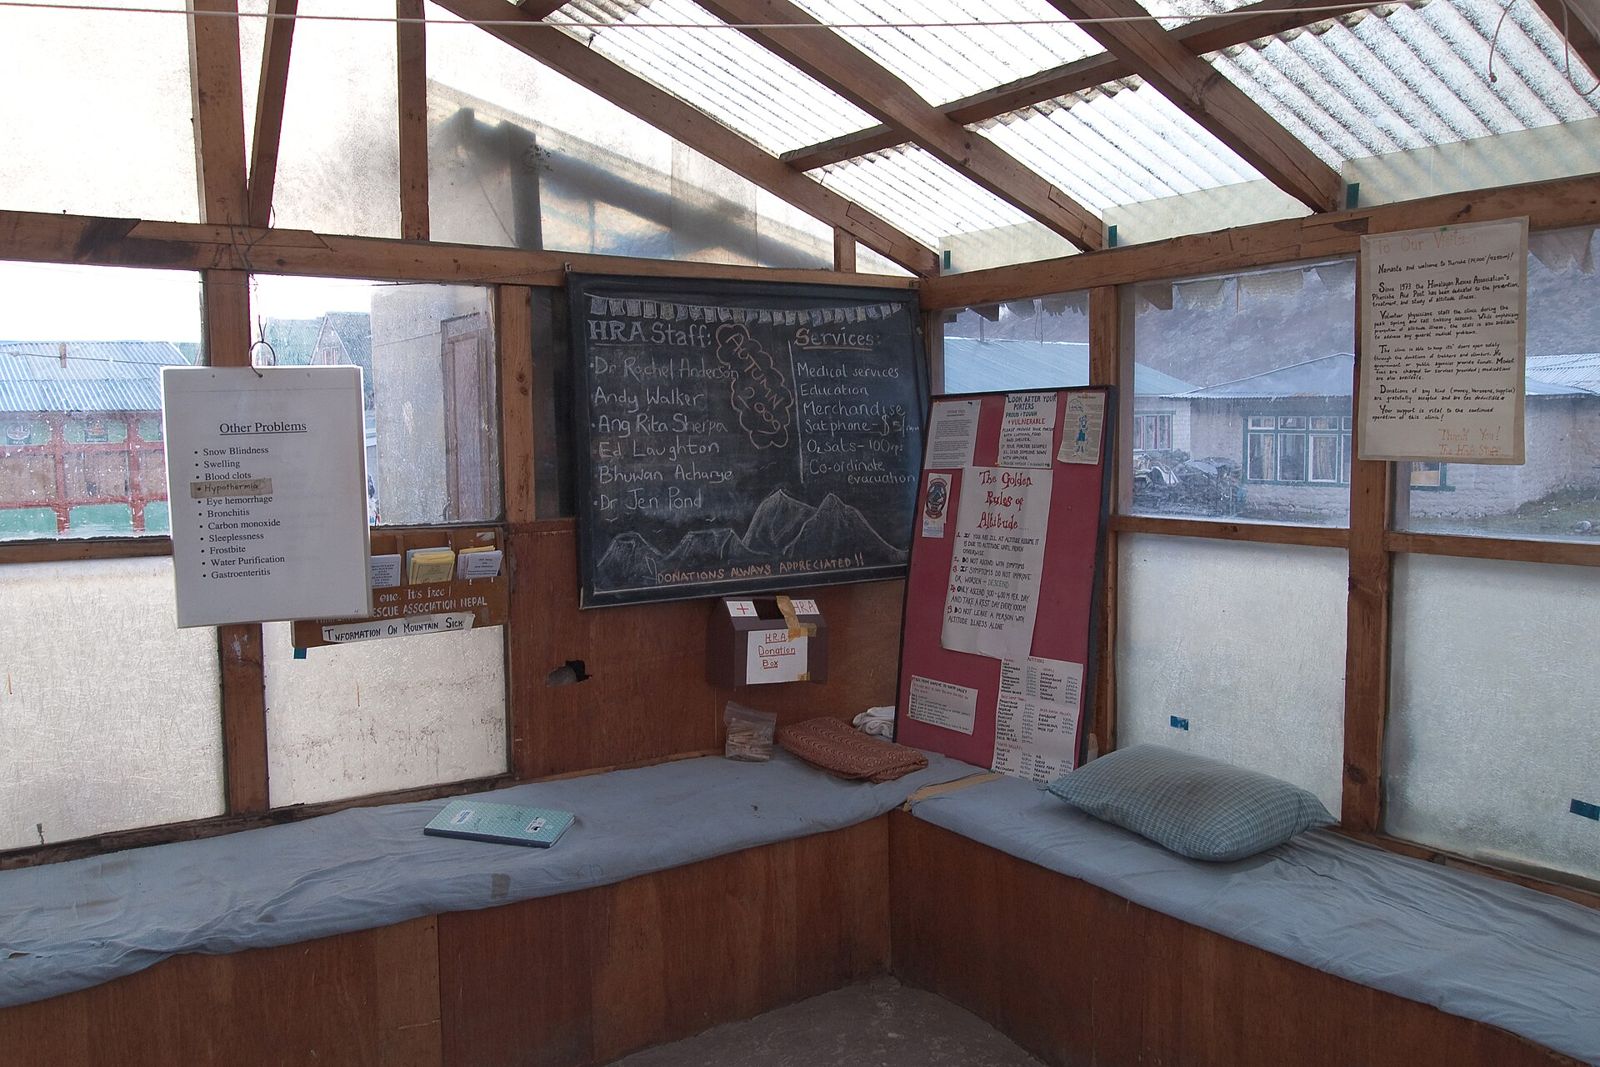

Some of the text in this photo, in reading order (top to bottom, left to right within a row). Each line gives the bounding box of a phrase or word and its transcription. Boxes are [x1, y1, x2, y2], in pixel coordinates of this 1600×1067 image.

[1378, 264, 1402, 274] Namaste
[1379, 282, 1394, 293] Since
[1427, 280, 1454, 288] Himalayan
[1455, 277, 1471, 285] Rescue
[1380, 310, 1403, 319] Volunteer
[588, 320, 711, 348] HRA Staff:
[794, 327, 880, 345] Services:
[624, 357, 674, 382] Rachel
[797, 363, 899, 378] Medical services
[800, 384, 869, 396] Education
[1380, 384, 1408, 394] Donations
[594, 386, 704, 413] Andy Walker
[1008, 395, 1022, 403] LOOK
[803, 401, 905, 416] Merchandise
[1379, 404, 1392, 414] Your
[1425, 414, 1444, 422] clinic!
[220, 421, 307, 434] Other Problems
[600, 413, 728, 438] Ang Rita Sherpa
[203, 446, 269, 456] Snow Blindness
[599, 435, 719, 461] Ed Laughton
[204, 460, 240, 469] Swelling
[809, 459, 885, 474] Co-ordinate
[205, 472, 230, 481] Blood
[600, 466, 663, 483] Bhuwan
[848, 472, 916, 484] evacuation
[979, 470, 1033, 489] The Golden
[204, 482, 259, 494] Hypothermia
[206, 495, 273, 506] Eye hemorrhage
[600, 487, 702, 512] Dr Jen Pond
[985, 491, 1013, 507] Rules
[207, 509, 250, 518] Bronchitis
[208, 519, 280, 530] Carbon monoxide
[977, 511, 1018, 529] Altitude
[209, 532, 264, 543] Sleeplessness
[210, 545, 246, 554] Frostbite
[210, 555, 285, 566] Water Purification
[211, 568, 270, 579] Gastroenteritis
[657, 568, 724, 584] DONATIONS
[731, 565, 771, 577] ALWAYS
[408, 589, 422, 599] It's
[427, 587, 444, 597] free
[372, 596, 487, 618] ESCUE ASSOCIATION NEPAL
[403, 622, 438, 633] MOUNTAIN
[758, 645, 795, 655] Donation
